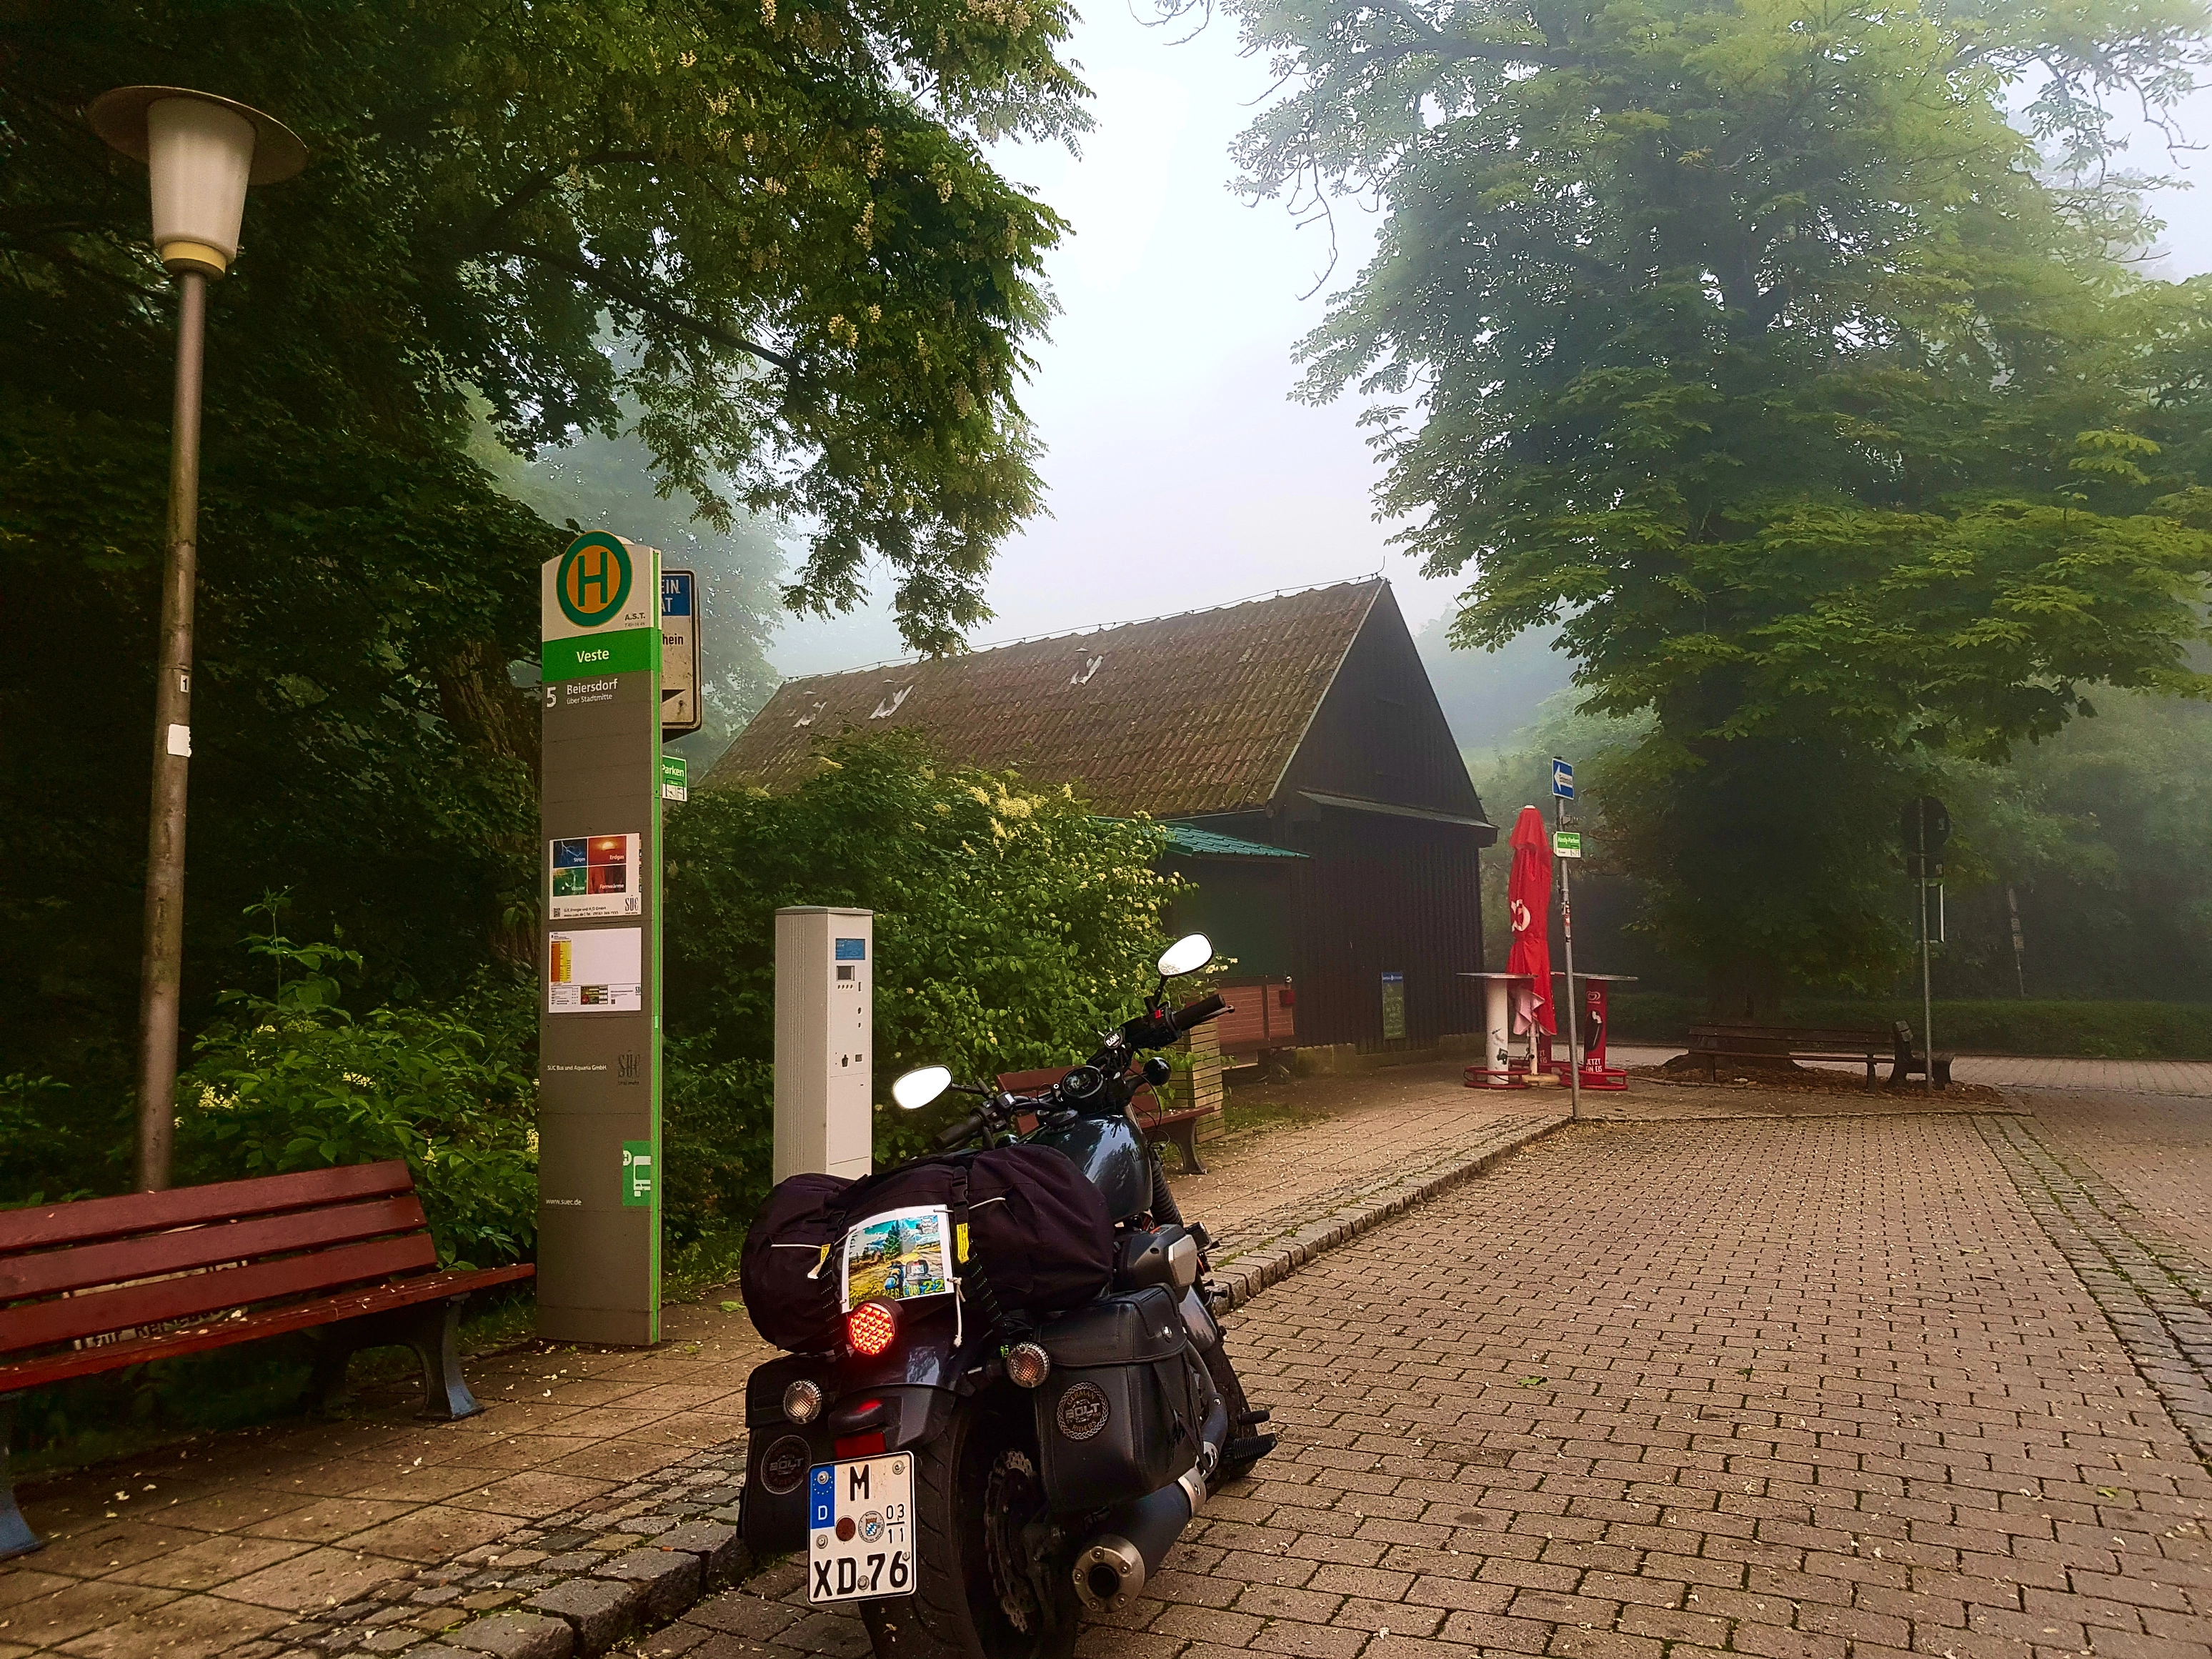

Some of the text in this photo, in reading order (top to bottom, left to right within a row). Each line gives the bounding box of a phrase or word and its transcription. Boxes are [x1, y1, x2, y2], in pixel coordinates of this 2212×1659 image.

[577, 552, 608, 607] H
[624, 612, 646, 621] A.S.T.
[577, 649, 609, 663] Veste
[183, 678, 187, 690] 1
[547, 678, 618, 708] 5 Beiersdorf
[581, 693, 613, 703] Stadtmitte
[1067, 1390, 1096, 1405] GERMAN
[1065, 1403, 1100, 1419] BOLT
[1072, 1421, 1097, 1432] RIDERS
[769, 1458, 804, 1472] BOLT
[850, 1464, 870, 1501] M
[818, 1505, 828, 1520] D
[886, 1503, 905, 1519] 03
[888, 1528, 904, 1543] 11
